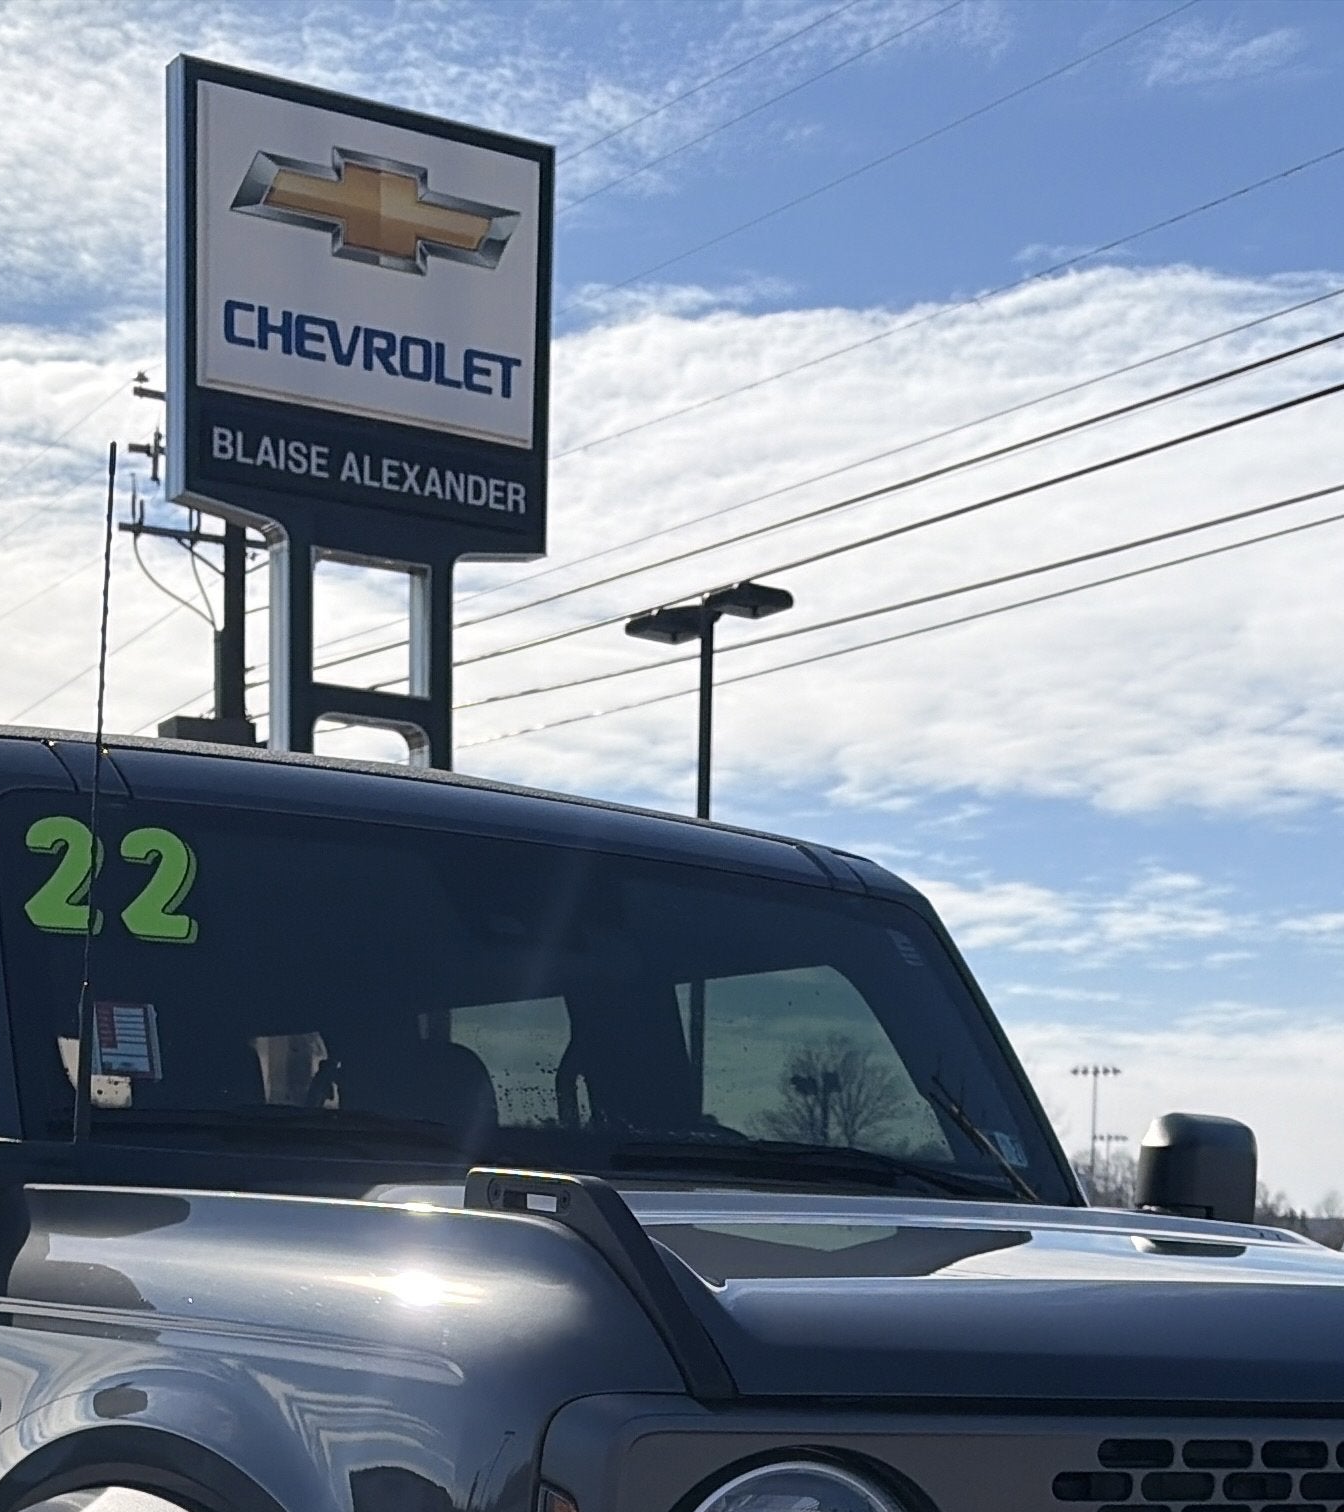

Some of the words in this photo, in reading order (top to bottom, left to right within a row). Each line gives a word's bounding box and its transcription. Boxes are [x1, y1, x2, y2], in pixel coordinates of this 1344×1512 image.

[224, 300, 522, 398] CHEVROLET
[213, 427, 329, 479] BLAISE
[340, 451, 526, 513] ALEXANDER
[24, 816, 199, 944] 22
